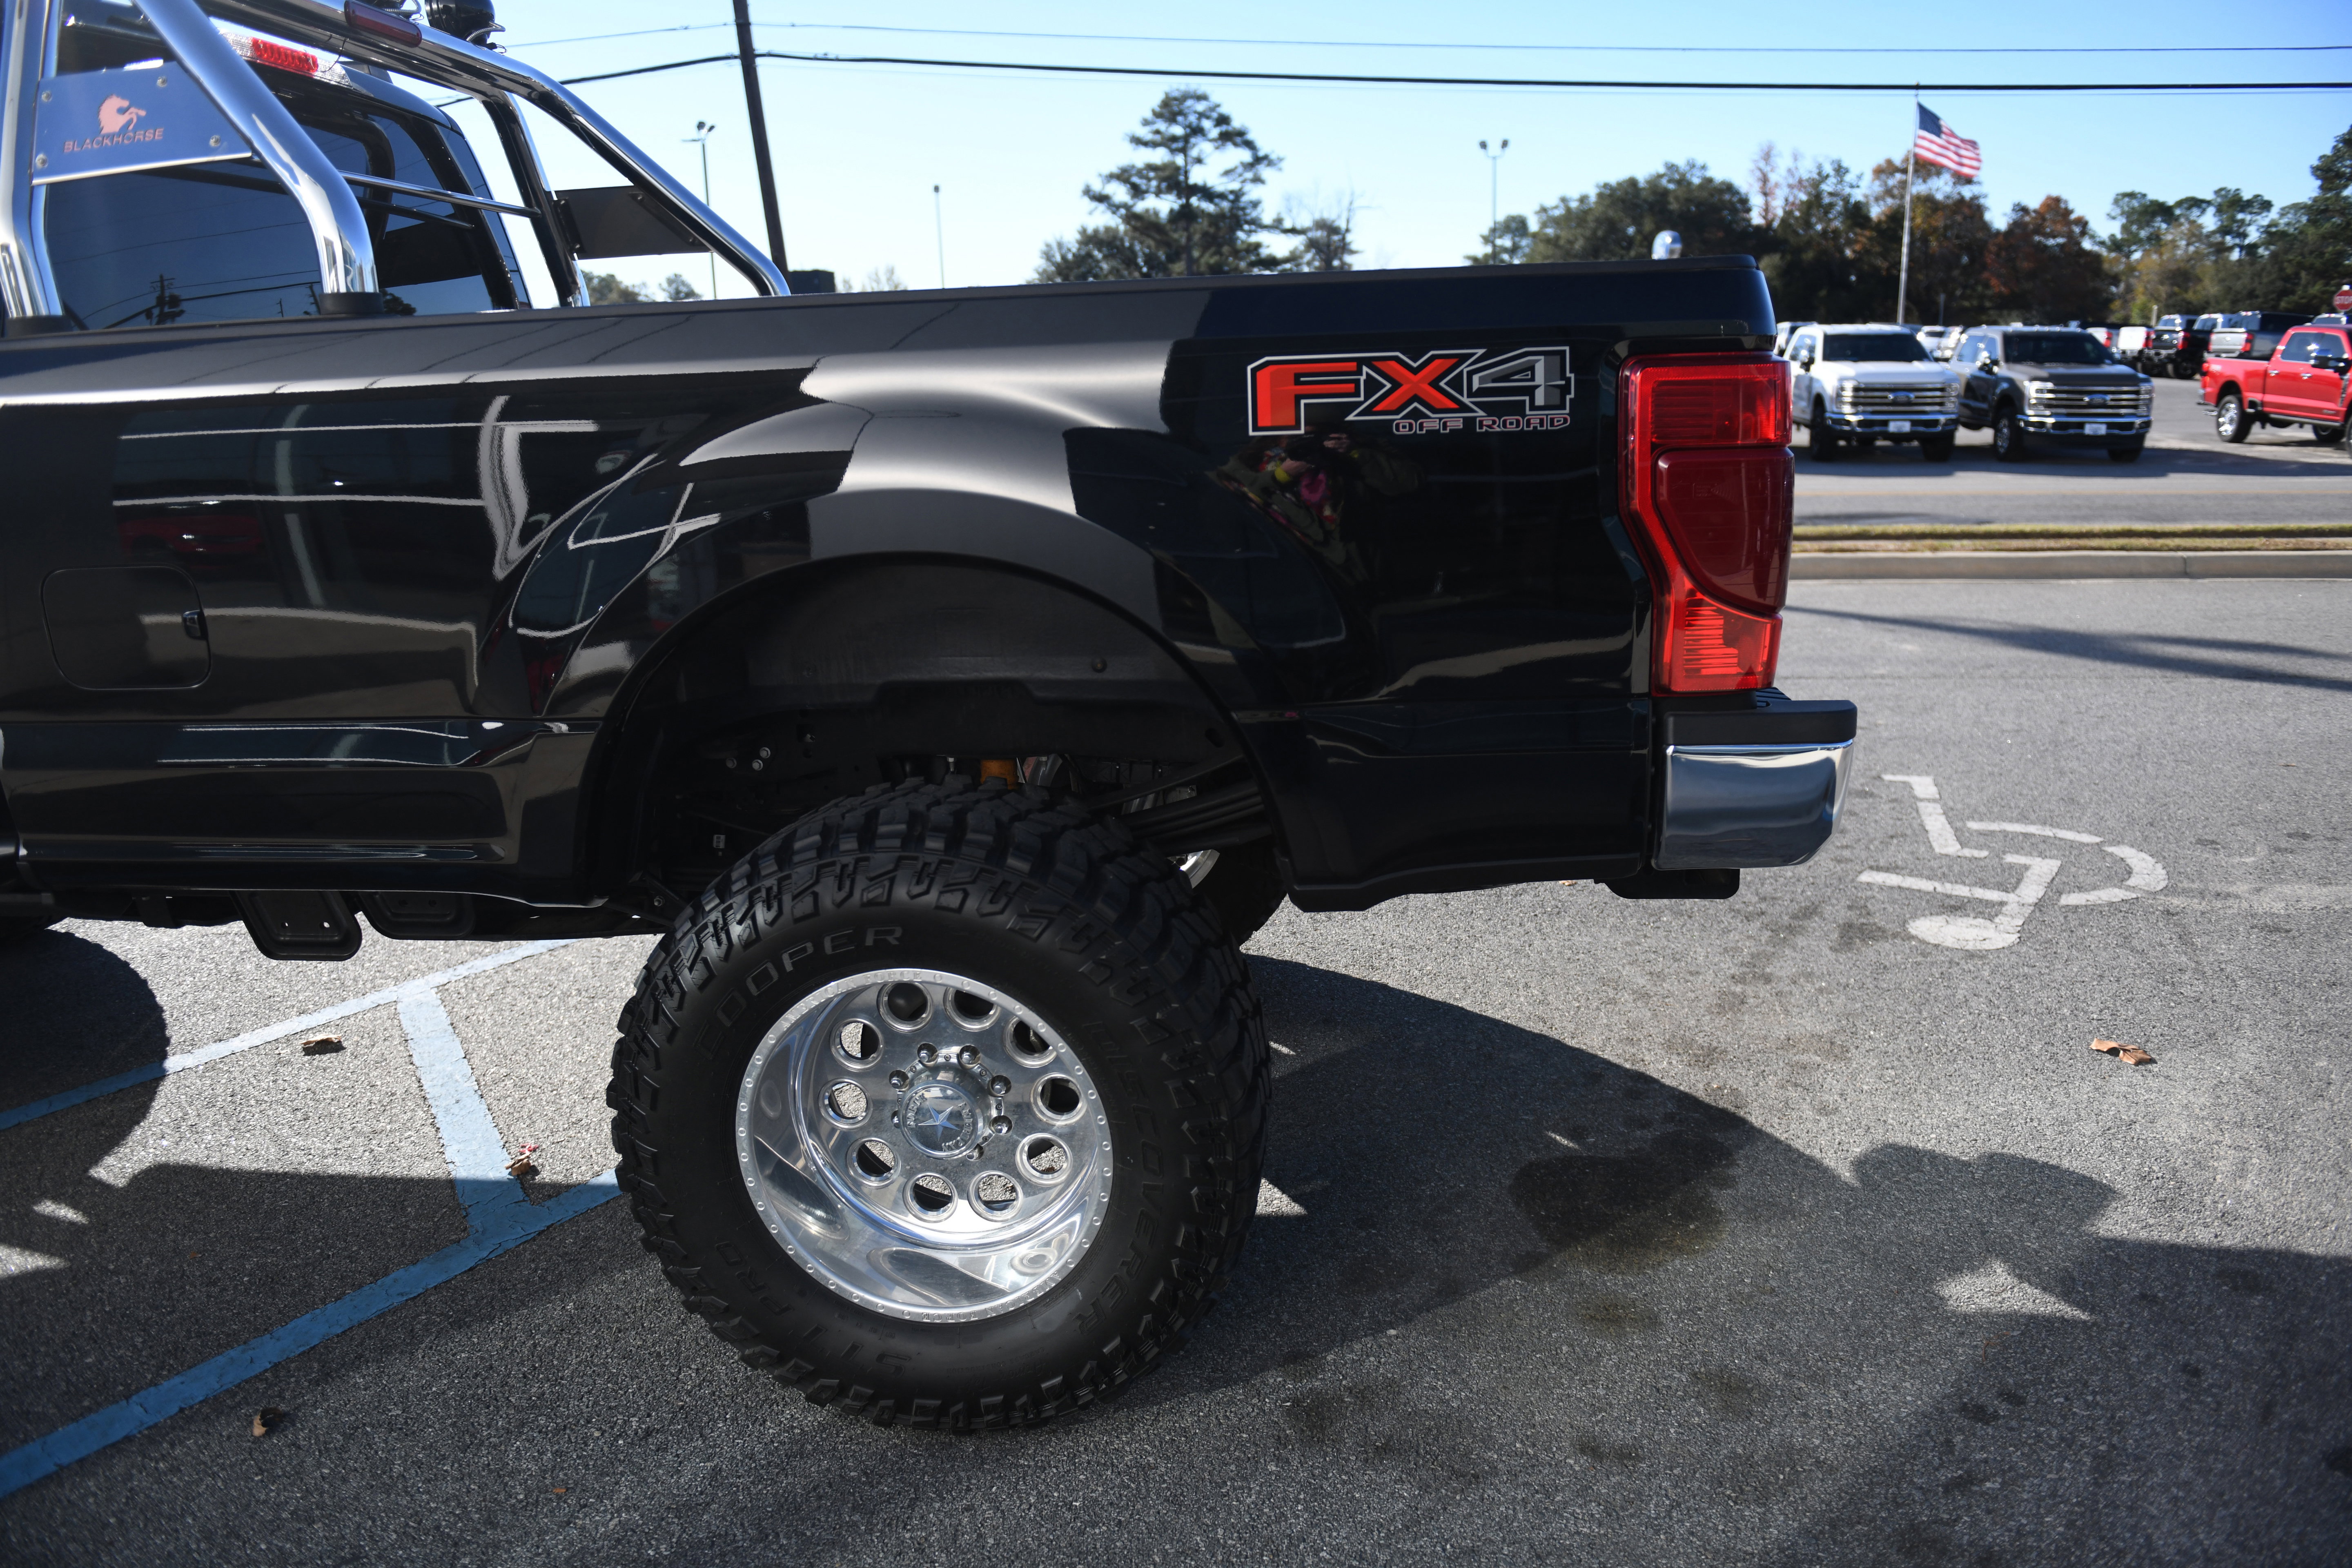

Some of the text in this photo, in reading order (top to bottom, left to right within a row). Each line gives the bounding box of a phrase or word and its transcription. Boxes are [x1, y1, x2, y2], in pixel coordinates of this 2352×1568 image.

[63, 127, 164, 153] BLACKHORSE
[1247, 347, 1574, 436] FX4
[1393, 414, 1570, 435] OFF ROAD
[695, 925, 903, 1061] COOPER
[782, 969, 922, 1031] AMERICAN FORCE
[1072, 1021, 1165, 1335] DISCOVERER
[715, 1241, 795, 1316] PRO
[922, 1270, 1062, 1322] AMERICAN FORCE
